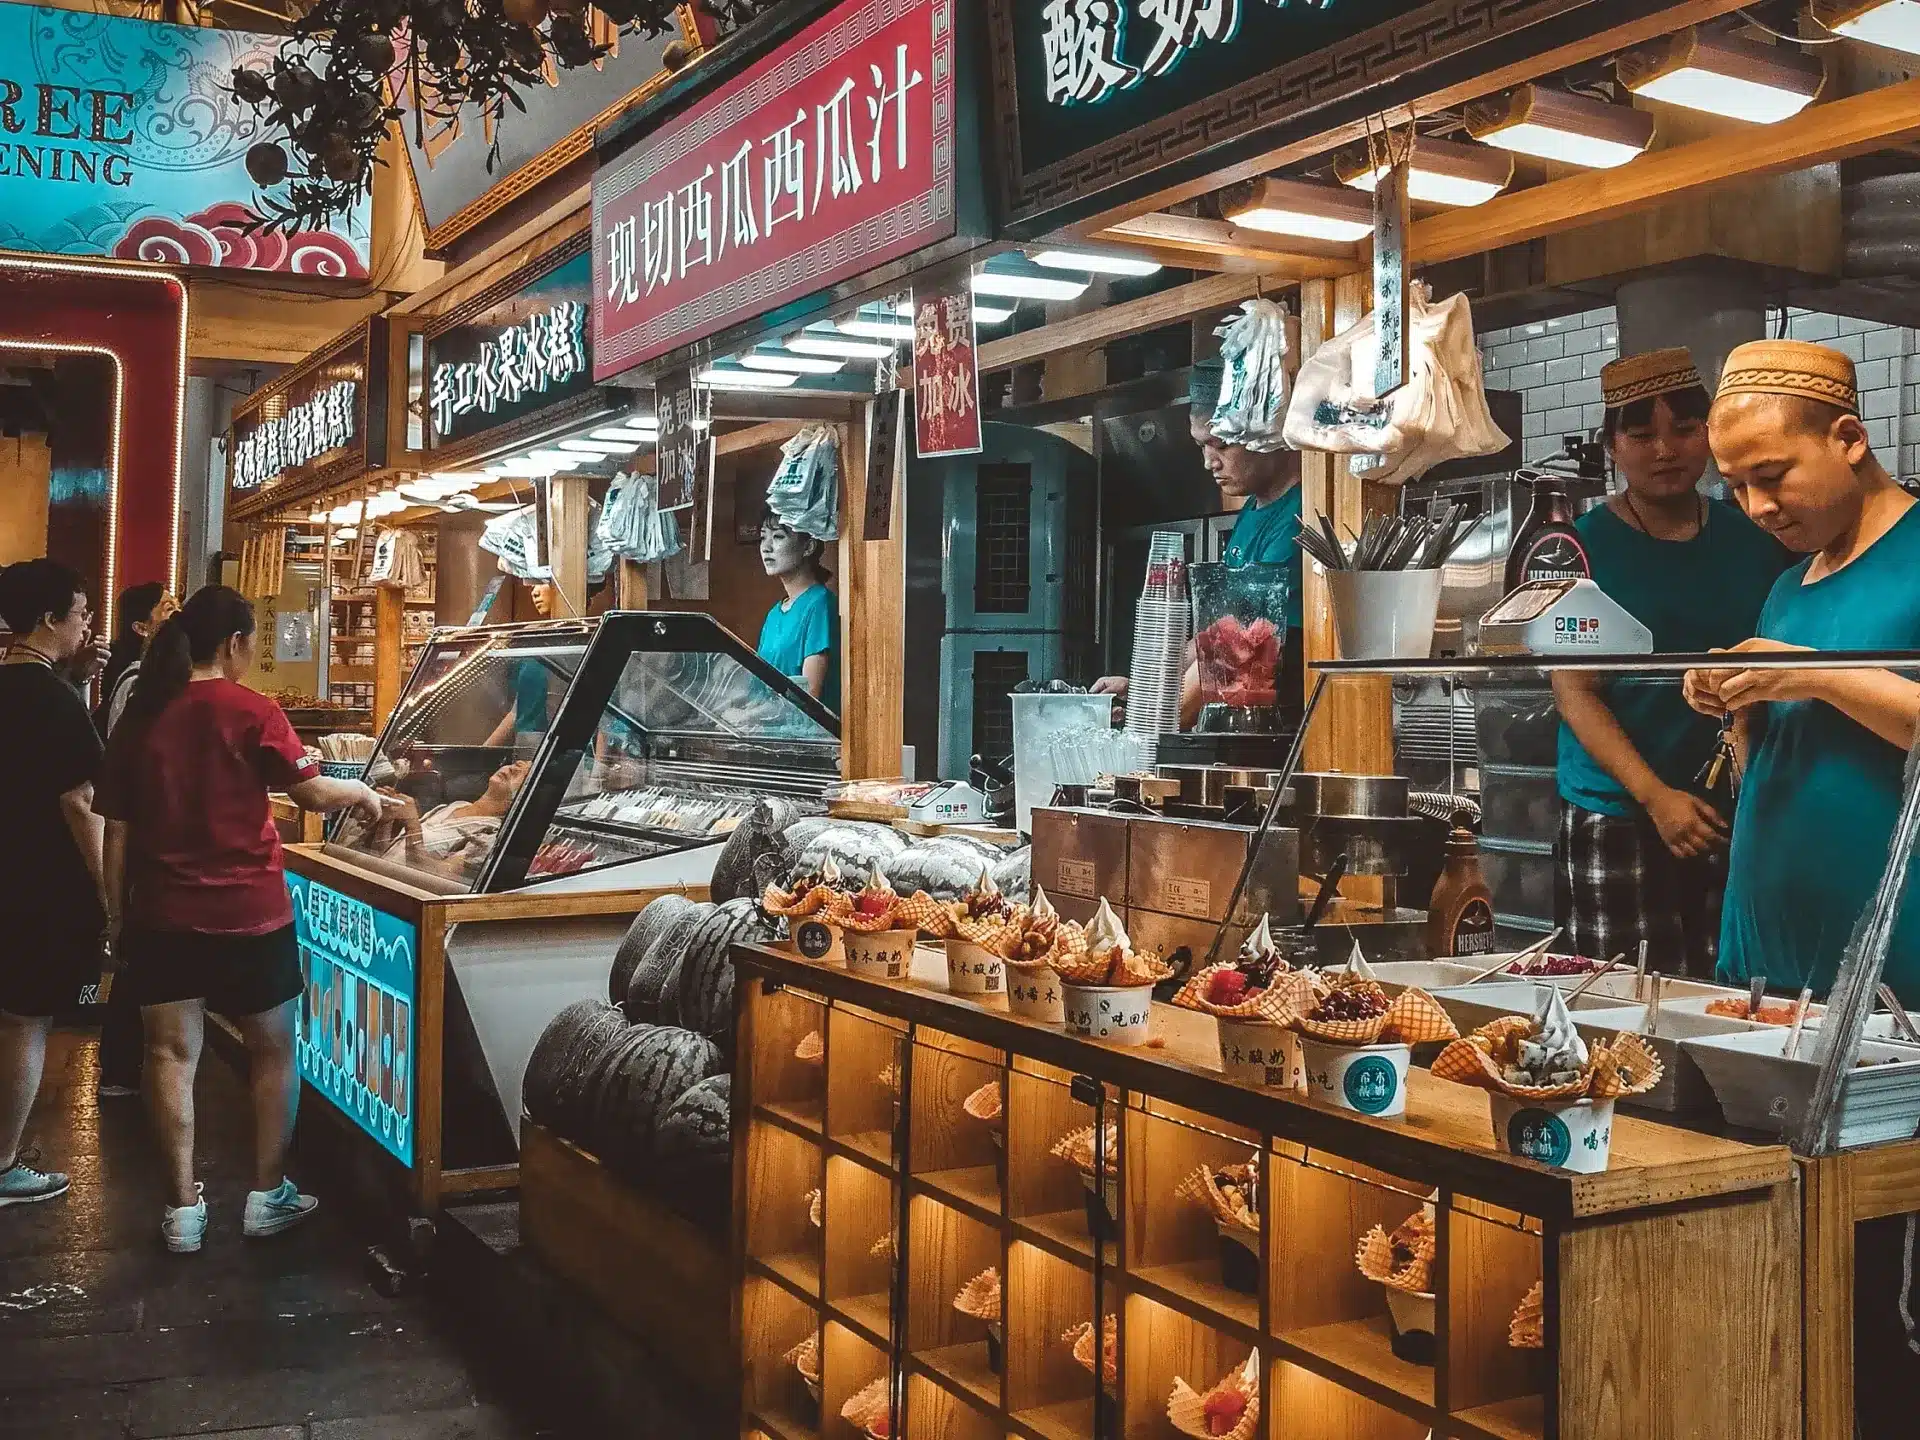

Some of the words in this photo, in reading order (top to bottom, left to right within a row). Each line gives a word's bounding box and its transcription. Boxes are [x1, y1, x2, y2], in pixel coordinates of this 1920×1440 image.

[1042, 0, 1334, 106] 酸奶
[606, 43, 922, 311] 现切西瓜西瓜汁
[915, 292, 971, 356] 免费
[430, 301, 580, 435] 手工水果冰糕
[919, 363, 975, 421] 加冰
[658, 388, 692, 437] 免费
[660, 440, 695, 484] 加冰
